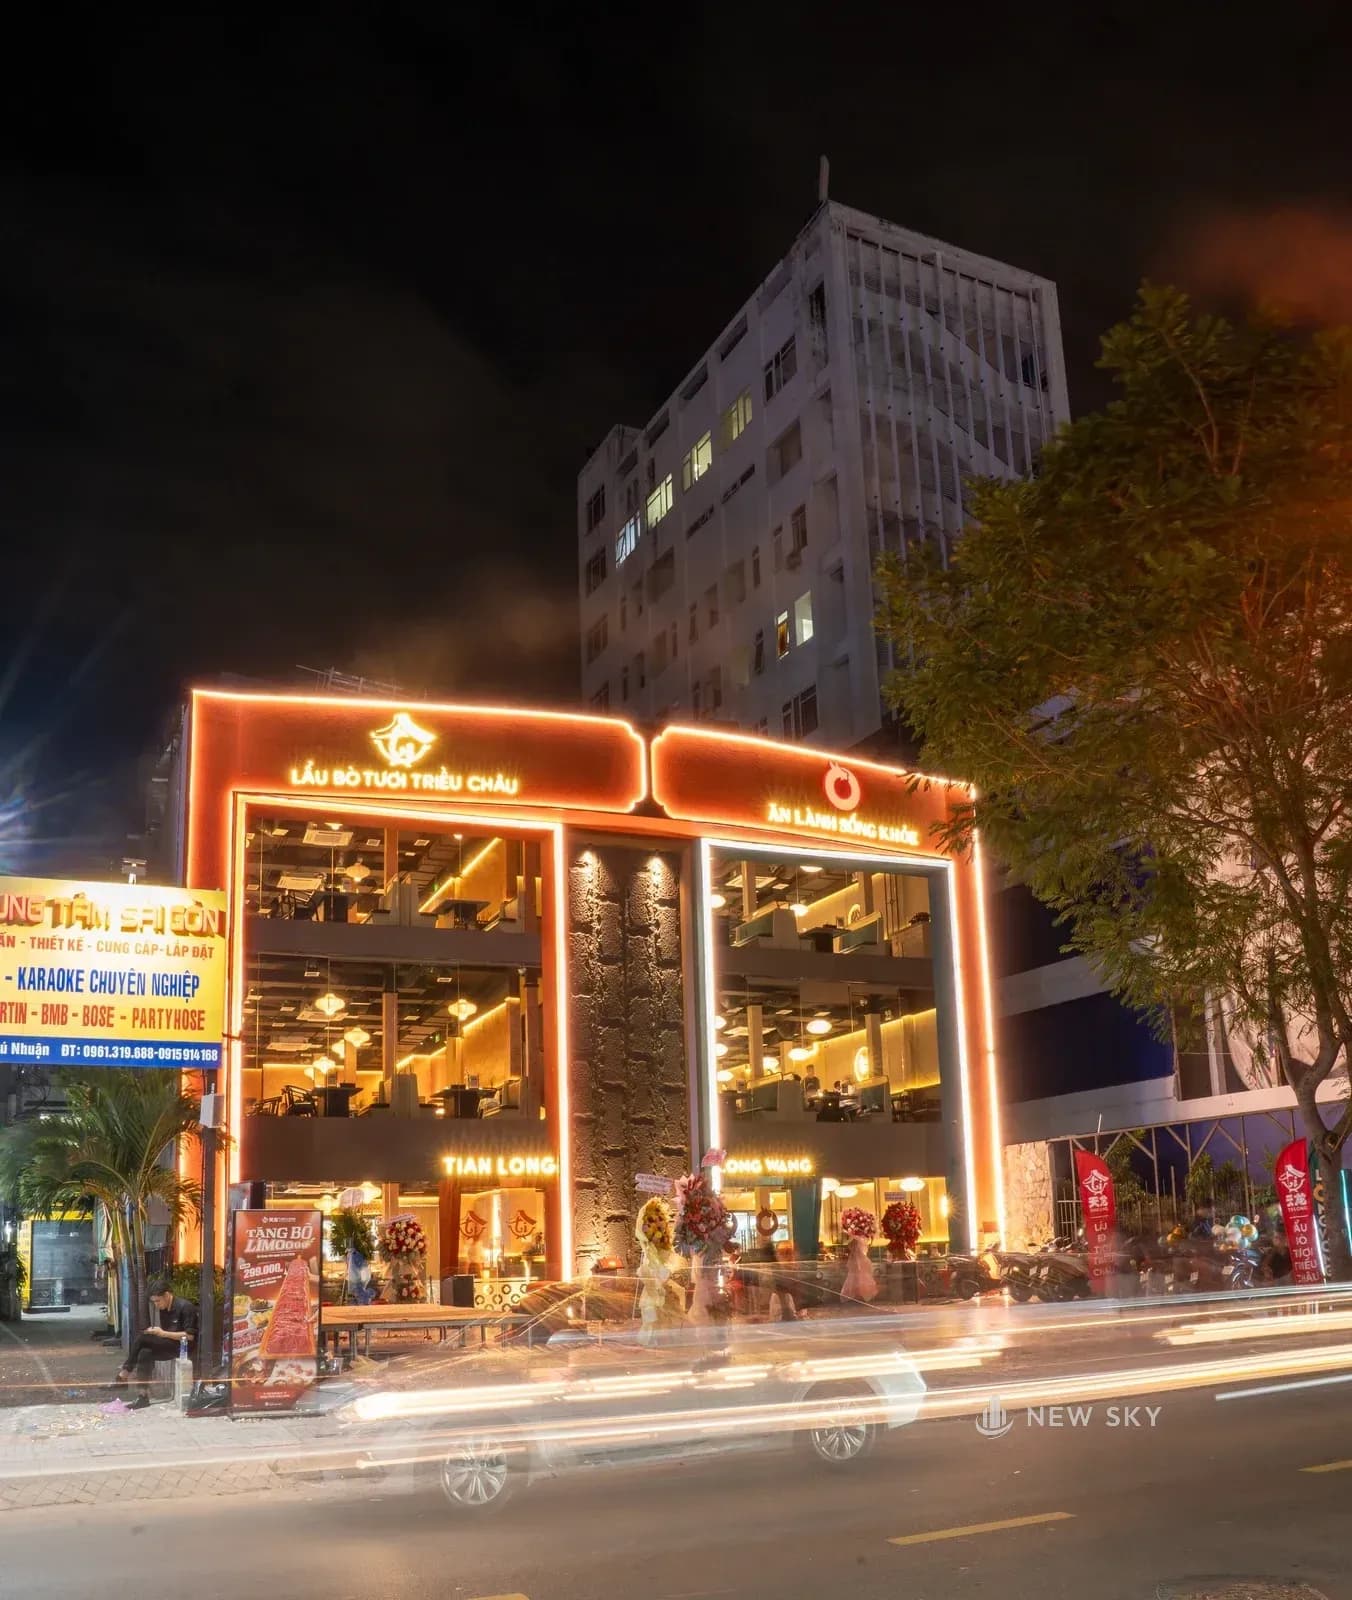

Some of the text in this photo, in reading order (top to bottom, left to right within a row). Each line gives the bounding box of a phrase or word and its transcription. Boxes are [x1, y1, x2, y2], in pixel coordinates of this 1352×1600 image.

[333, 765, 361, 786] BÒ
[96, 940, 130, 954] CUNG
[18, 966, 200, 1003] KARAOKE CHUYÊN NGHIỆP
[41, 1003, 68, 1025] BMB
[82, 1005, 115, 1028] BOSE
[132, 1007, 206, 1031] PARTYHOSE
[11, 1042, 50, 1059] Nhuận
[442, 1156, 556, 1175] TIAN LONG
[764, 1157, 812, 1173] WANG
